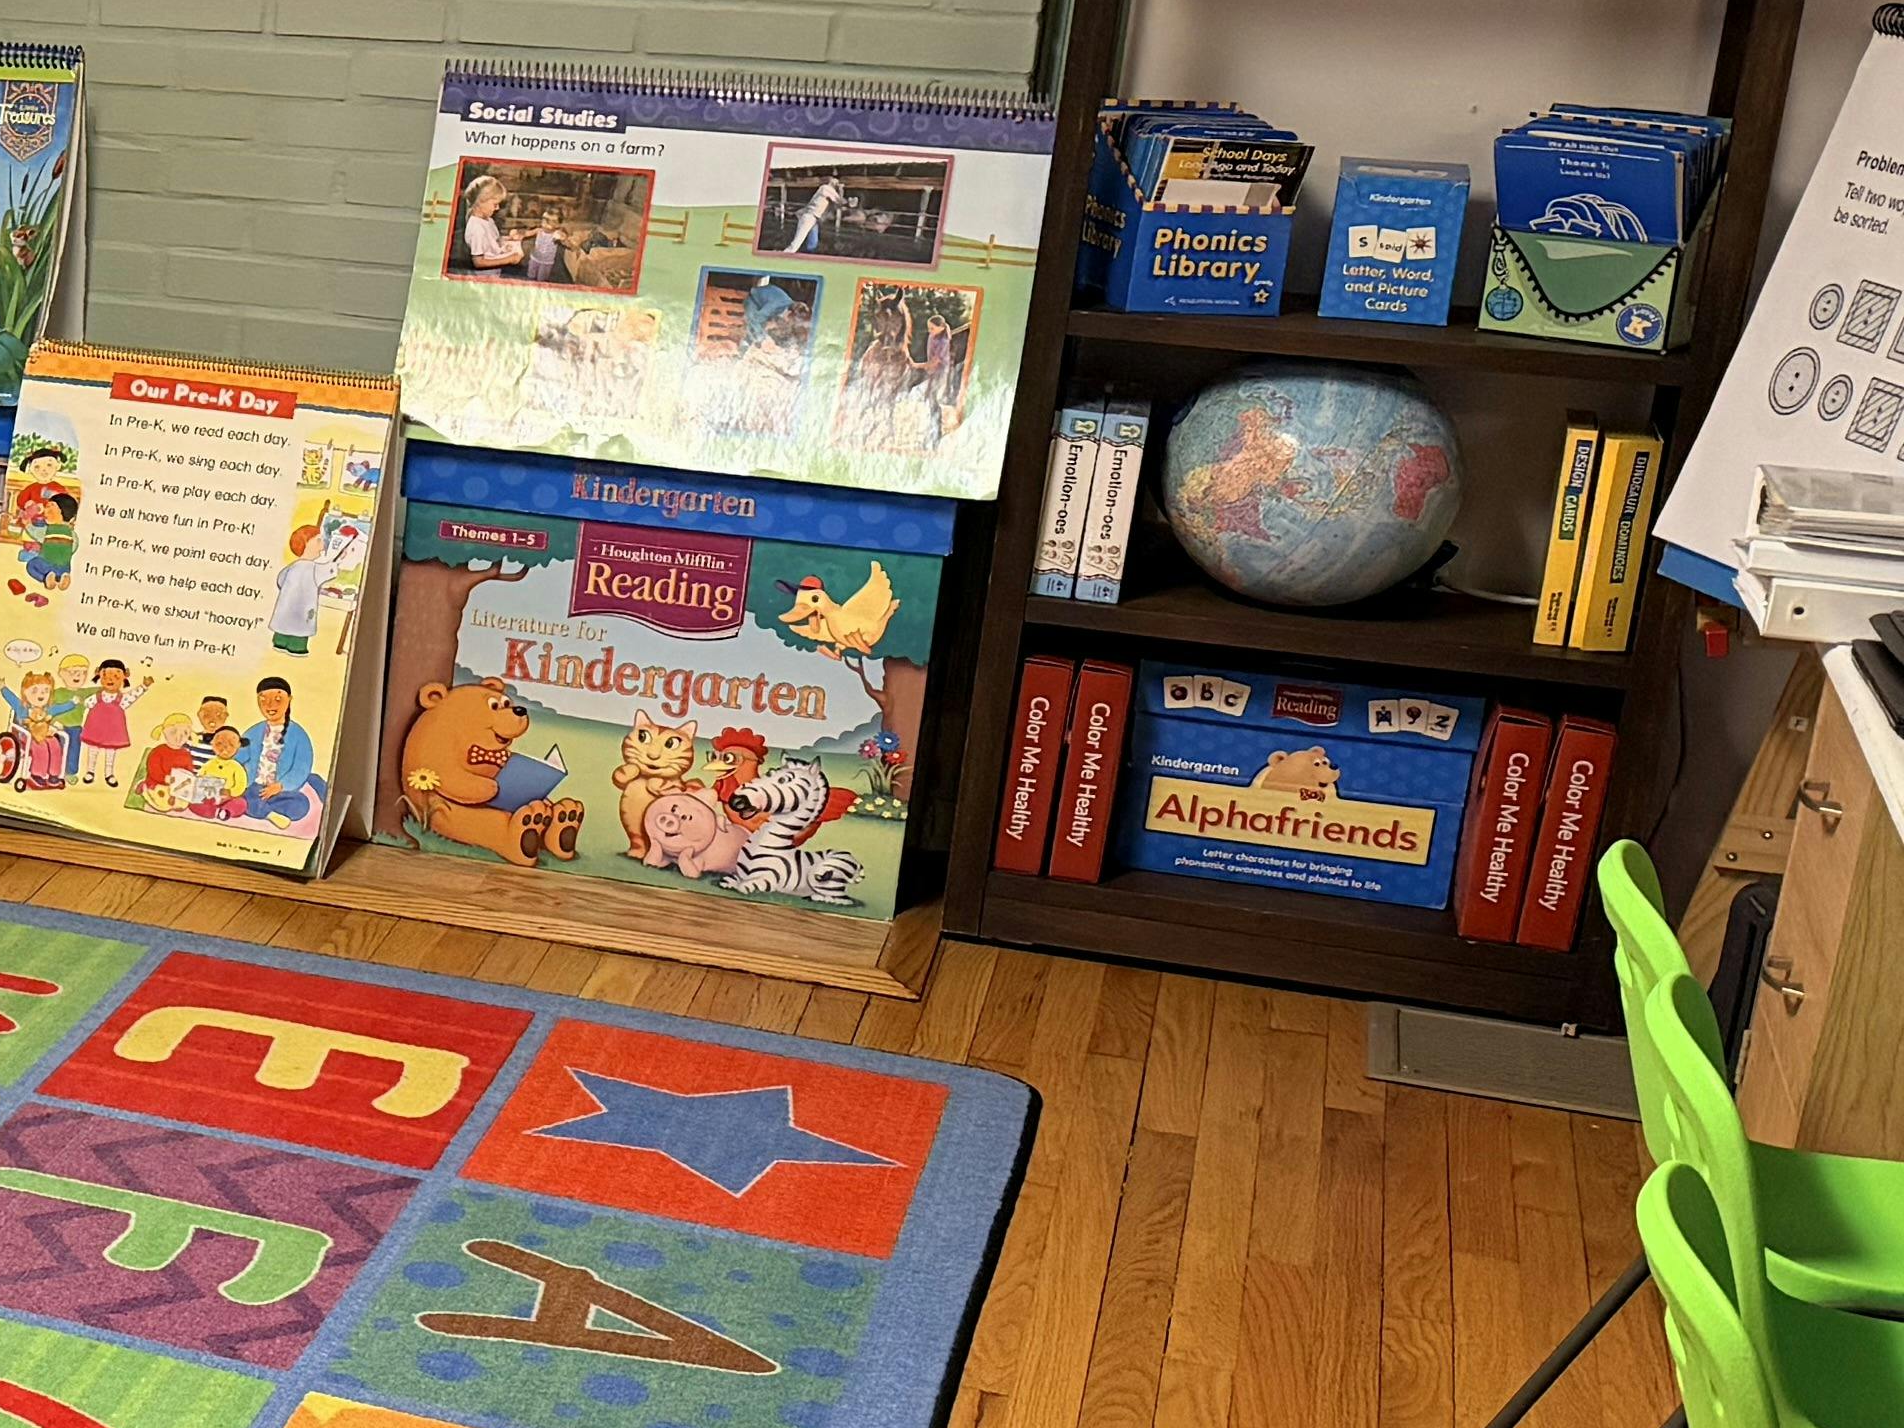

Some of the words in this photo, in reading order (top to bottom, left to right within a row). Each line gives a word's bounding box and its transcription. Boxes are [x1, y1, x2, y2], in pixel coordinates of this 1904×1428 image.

[468, 101, 533, 123] Social
[540, 105, 618, 130] Studies
[464, 130, 506, 146] What
[511, 134, 576, 152] happens
[581, 140, 602, 153] on
[605, 141, 616, 154] a
[620, 140, 666, 157] farm?
[1845, 181, 1865, 202] Tell
[1865, 189, 1886, 207] two
[1834, 206, 1849, 224] be
[1850, 213, 1890, 235] sorted.
[1154, 227, 1269, 253] Phonics
[1152, 254, 1261, 285] Library
[1342, 263, 1387, 280] Letter,
[1392, 266, 1435, 283] Word,
[1345, 280, 1373, 295] and
[1377, 282, 1429, 298] Picture
[1365, 297, 1409, 314] Cards
[130, 378, 170, 401] Our
[174, 384, 233, 410] Pre-K
[239, 390, 280, 416] Day
[109, 414, 123, 428] In
[126, 416, 166, 435] Pre-K,
[171, 422, 190, 435] we
[193, 423, 223, 438] read
[227, 427, 259, 443] each
[263, 430, 292, 449] day.
[104, 443, 117, 457] In
[120, 445, 161, 465] Pre-K,
[164, 452, 184, 465] we
[188, 452, 216, 473] sing
[219, 457, 251, 473] each
[255, 460, 283, 479] day.
[1570, 445, 1590, 489] DESIGN
[570, 472, 757, 518] Kindergarten
[1561, 494, 1578, 533] CARDS
[451, 524, 506, 544] Themes
[600, 543, 672, 565] Houghton
[674, 550, 726, 570] Mifflin
[584, 561, 738, 622] Reading
[470, 607, 570, 639] Literature
[575, 617, 608, 643] for
[503, 636, 828, 722] Kindergarten
[1022, 695, 1050, 742] Color
[1276, 694, 1338, 722] Reading
[1019, 744, 1042, 774] Me
[1150, 753, 1240, 778] Kindergarten
[1503, 752, 1530, 802] Color
[1006, 776, 1036, 841] Healthy
[1154, 793, 1419, 852] Alphafriends
[1496, 803, 1520, 833] Me
[1480, 836, 1515, 904] Healthy
[121, 1004, 467, 1123] E
[410, 1237, 784, 1379] A
